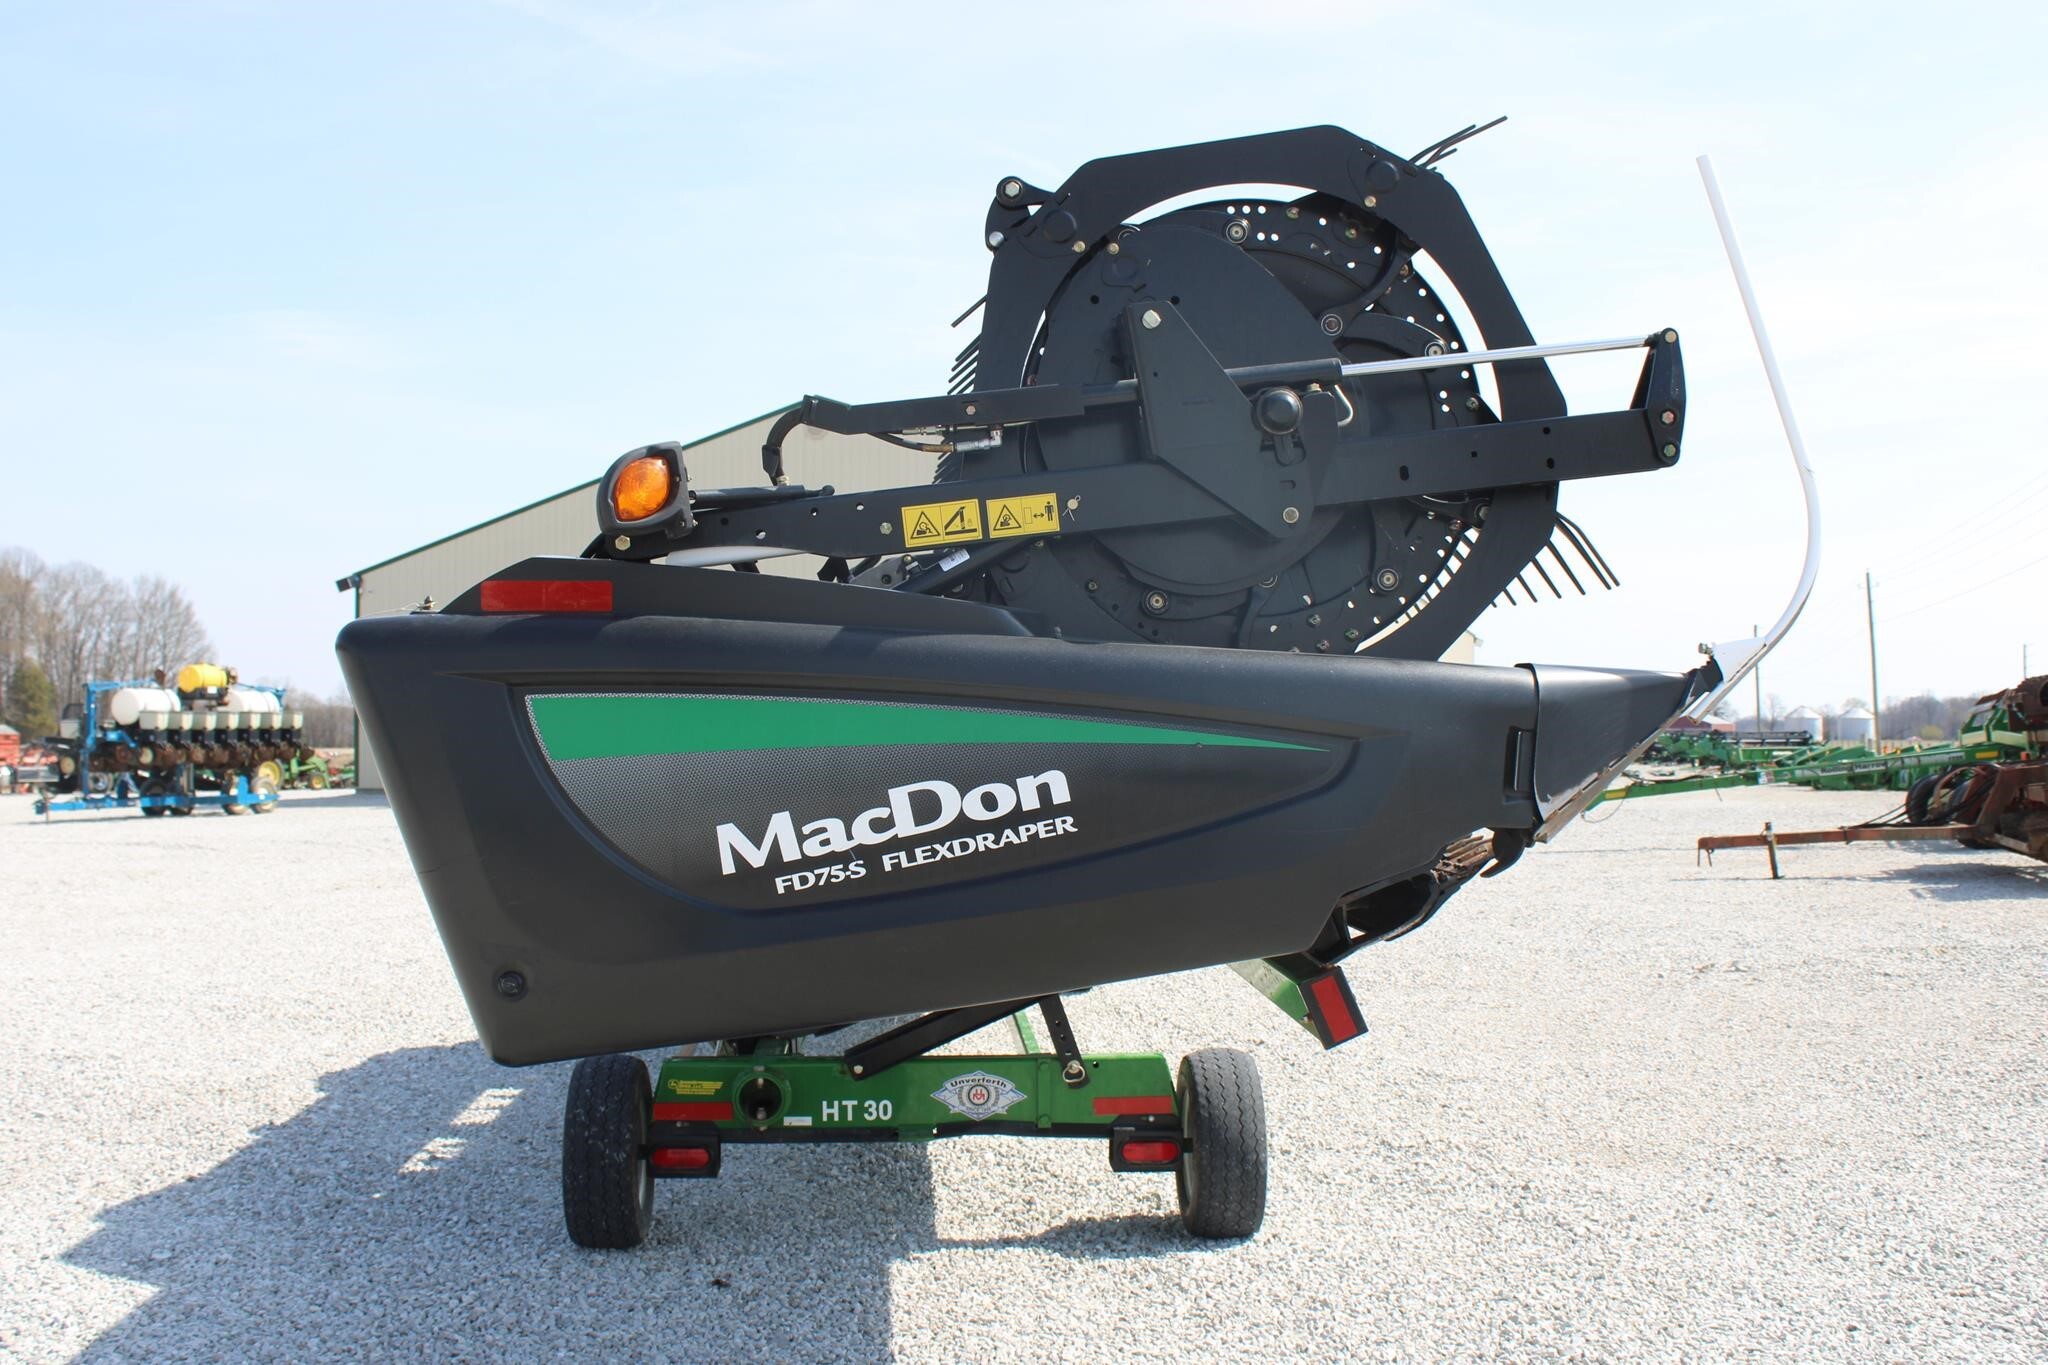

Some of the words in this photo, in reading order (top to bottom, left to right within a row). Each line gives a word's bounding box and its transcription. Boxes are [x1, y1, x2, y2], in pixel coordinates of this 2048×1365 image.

[716, 769, 1071, 875] MacDon
[775, 860, 867, 895] FD75-S
[882, 815, 1078, 872] FLEXDRAPER
[950, 1077, 1007, 1088] Unverferth
[822, 1100, 858, 1122] HT
[864, 1100, 893, 1121] 30
